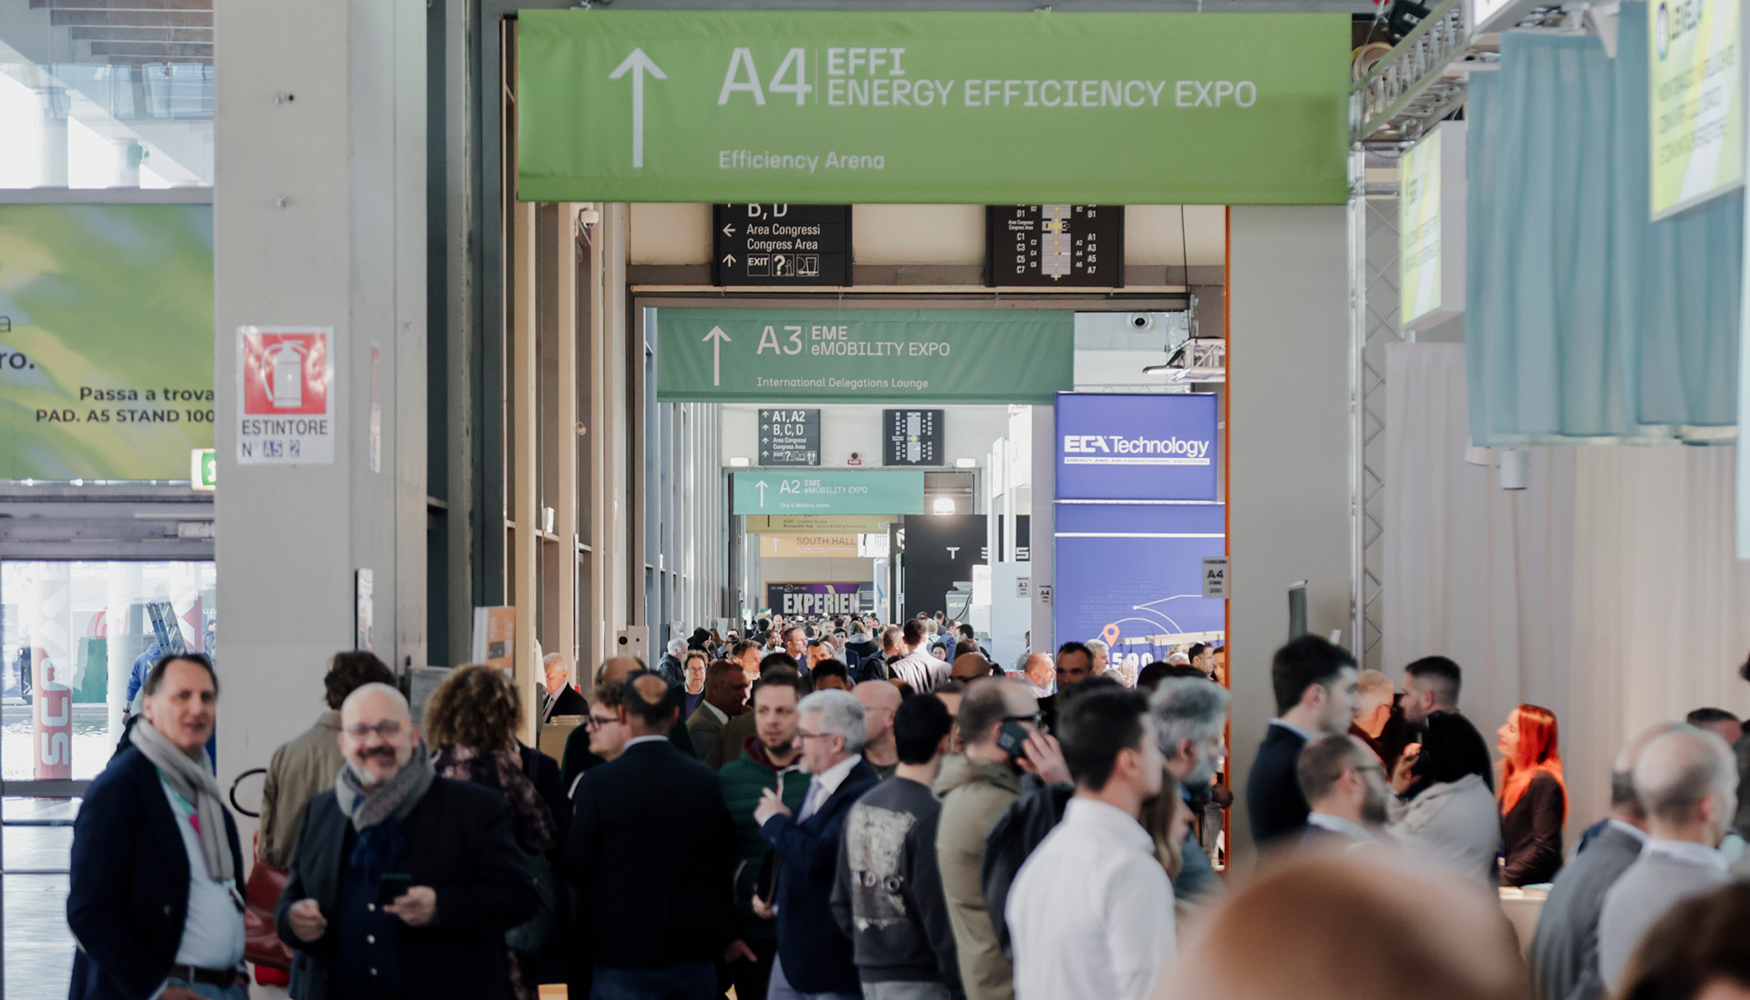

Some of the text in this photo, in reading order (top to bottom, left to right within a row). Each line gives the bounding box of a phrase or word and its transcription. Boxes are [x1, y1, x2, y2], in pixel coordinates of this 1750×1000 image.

[827, 47, 905, 76] EFFI
[718, 47, 812, 106] A4
[828, 79, 1258, 108] ENERGY EFFICIENCY EXPO
[719, 150, 885, 174] Efficiency Arena
[1087, 210, 1096, 218] B1
[746, 224, 821, 237] Area Congressi
[747, 238, 818, 252] Congress Area
[1017, 243, 1025, 251] C3
[1087, 244, 1096, 252] A3
[748, 257, 769, 267] EXIT
[1017, 255, 1025, 263] C5
[1087, 254, 1096, 262] A5
[1017, 266, 1025, 274] C7
[1087, 266, 1096, 274] A7
[811, 325, 848, 340] EME
[756, 325, 803, 355] A3
[811, 341, 950, 356] eMOBILITY EXPO
[756, 377, 928, 390] International Delegations Lounge
[80, 386, 215, 401] Passa a trova
[36, 409, 215, 423] PAD. A5 STAND 100
[772, 411, 806, 423] A1, A2
[242, 419, 328, 435] ESTINTORE
[773, 424, 804, 437] B, C, D
[290, 439, 300, 457] 2
[1064, 435, 1210, 458] ECA Technology
[780, 479, 801, 494] A2
[804, 479, 822, 487] EME
[804, 486, 868, 494] eMOBILITY EXPO
[796, 536, 856, 546] SOUTH HALL
[1207, 569, 1224, 579] A4
